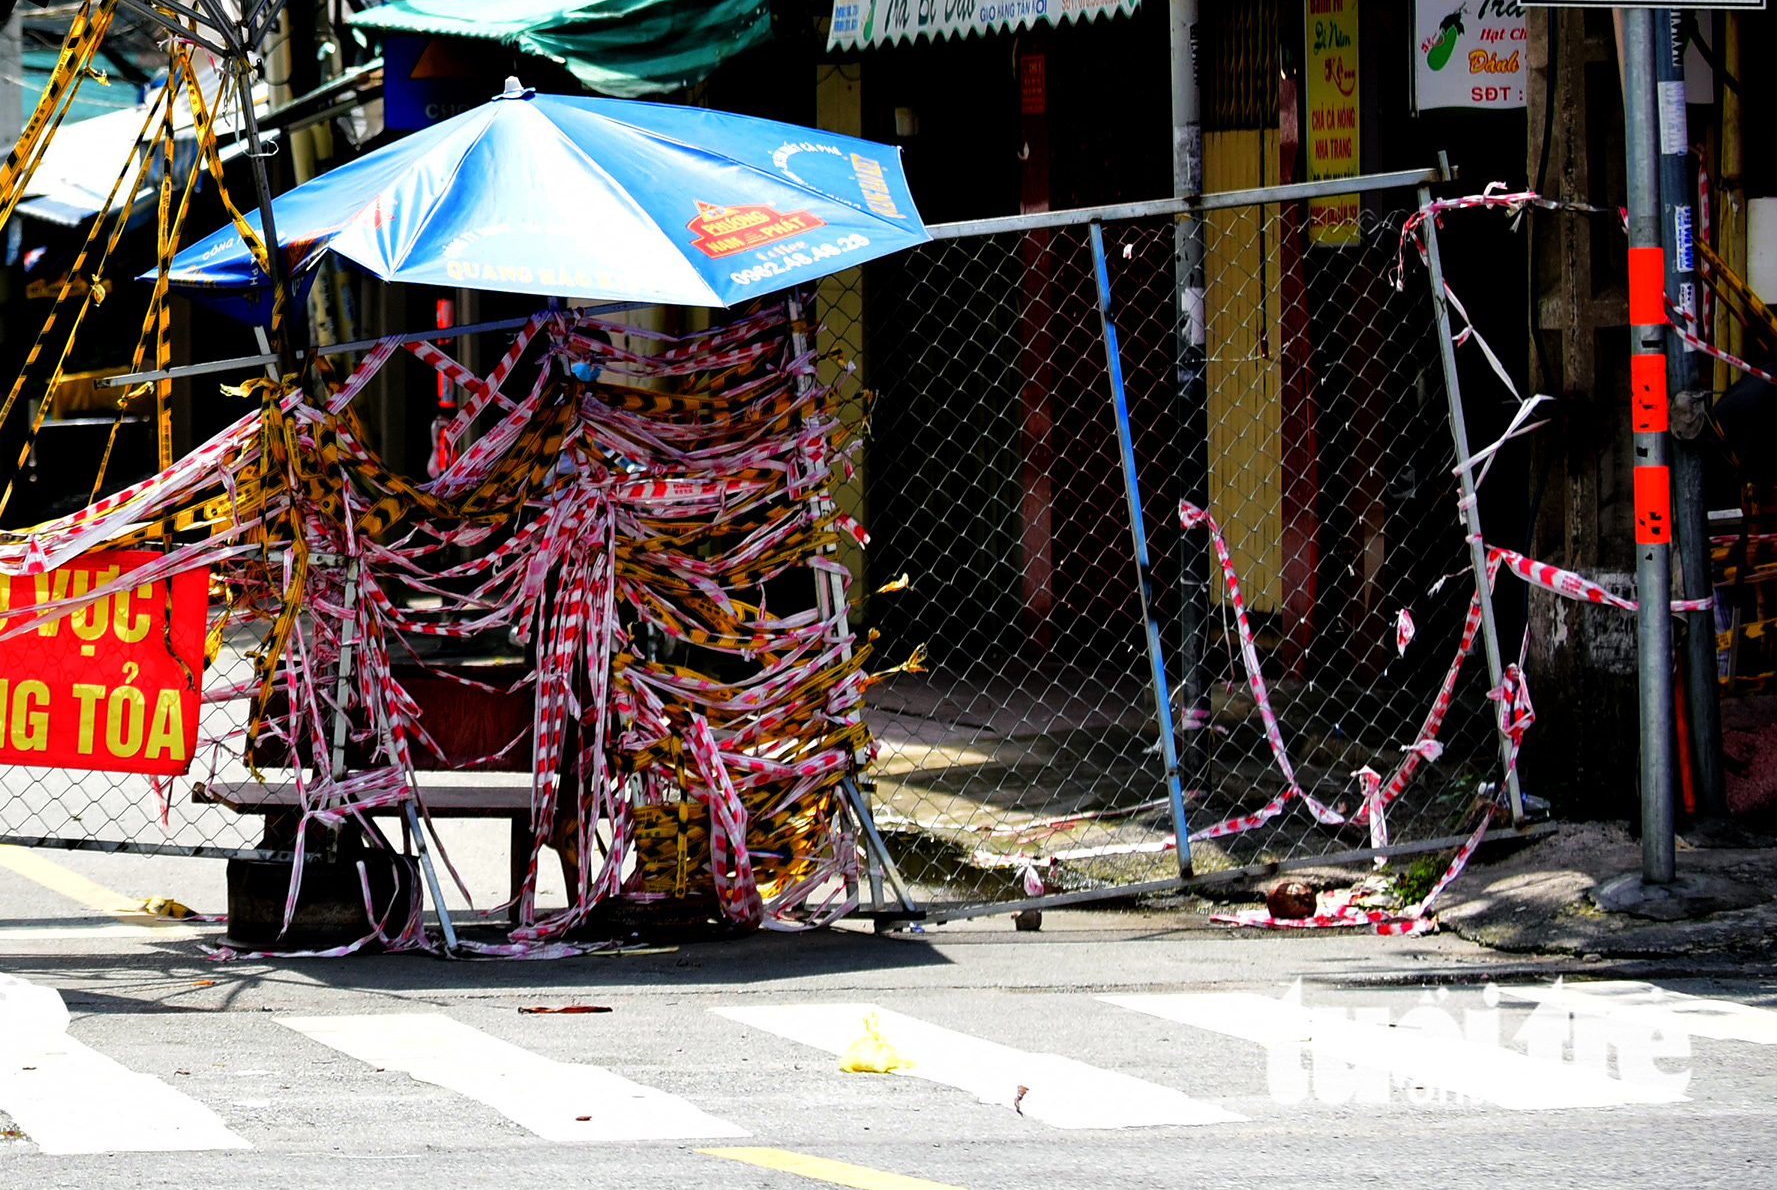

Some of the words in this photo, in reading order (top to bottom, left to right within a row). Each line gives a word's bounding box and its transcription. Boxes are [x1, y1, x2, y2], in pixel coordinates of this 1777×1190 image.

[1479, 27, 1506, 45] Hạt
[1330, 138, 1352, 160] TRANG
[701, 209, 771, 236] PHƯƠNG
[705, 236, 745, 254] NAM
[759, 215, 807, 238] PHÁT
[72, 660, 187, 763] TỎA
